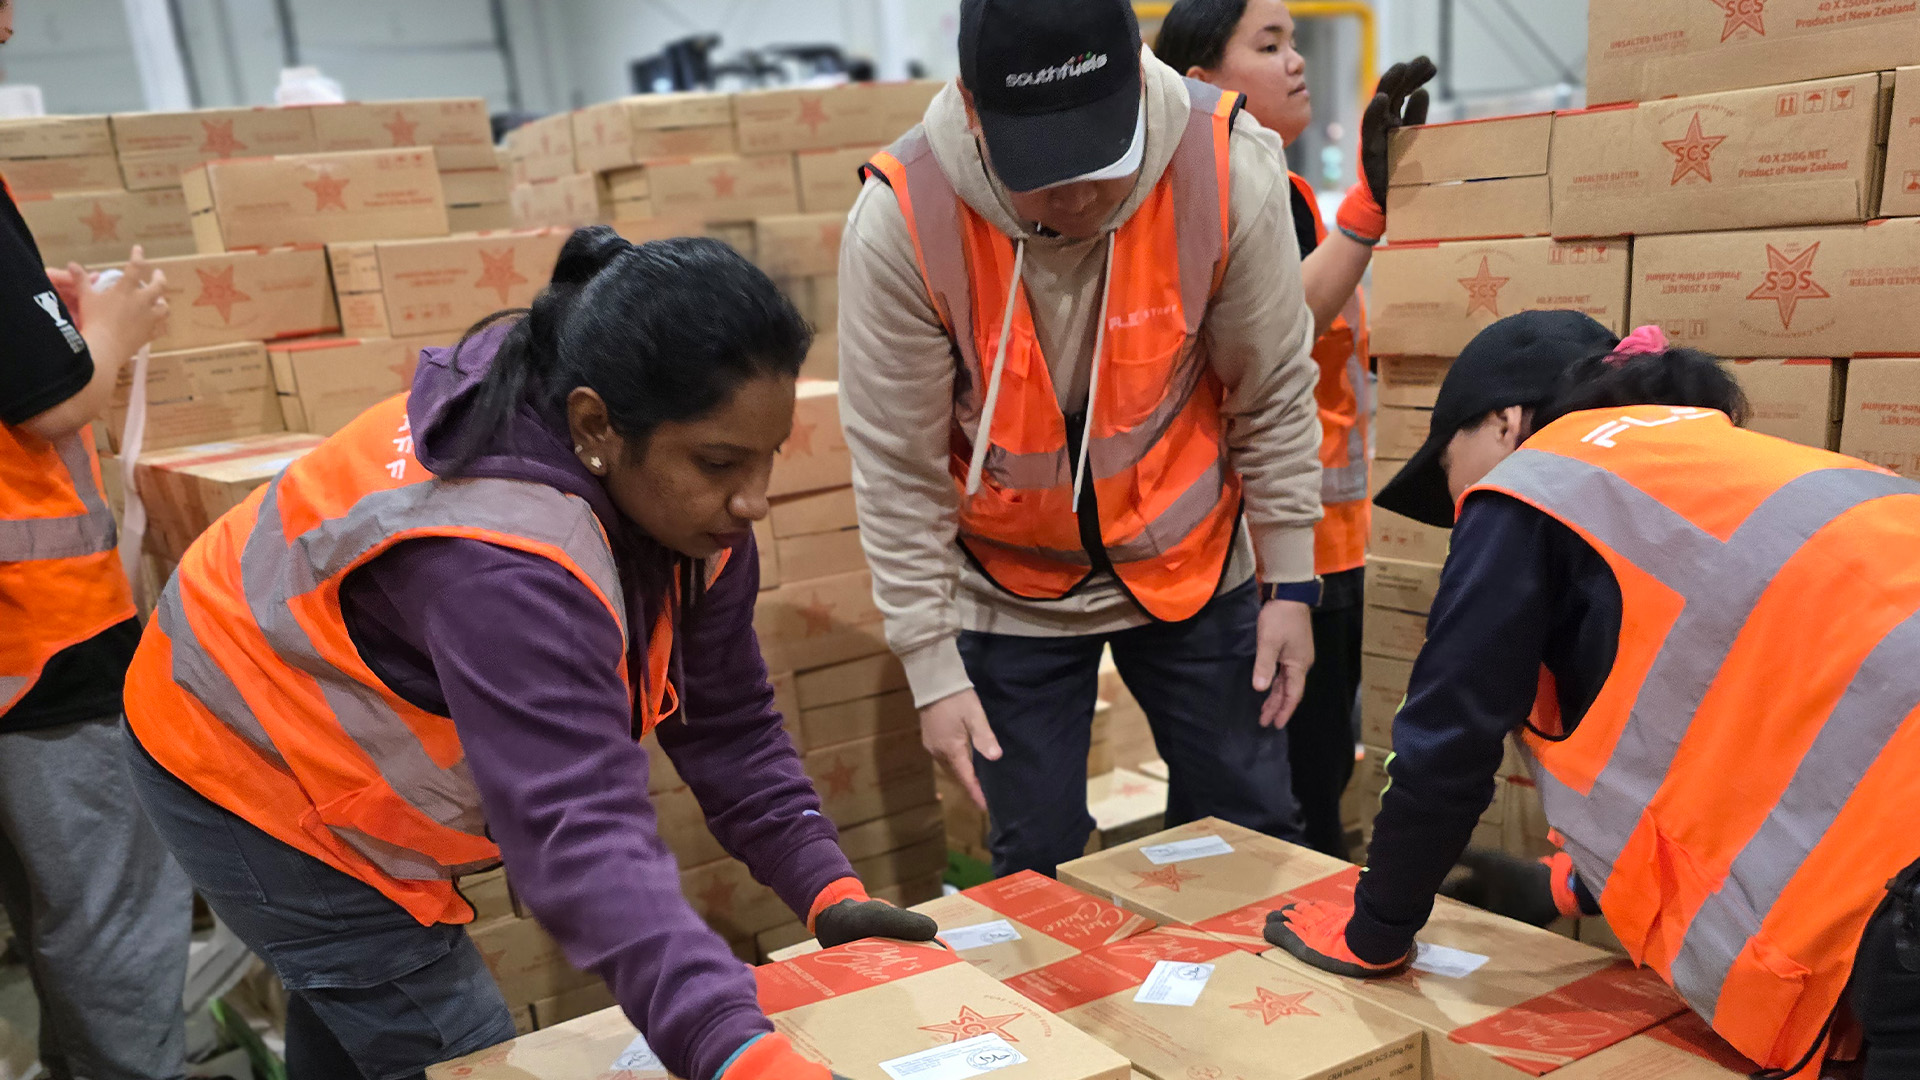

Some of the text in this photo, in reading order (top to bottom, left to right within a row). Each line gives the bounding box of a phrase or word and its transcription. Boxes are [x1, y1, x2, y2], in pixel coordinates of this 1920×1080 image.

[1724, 0, 1764, 18] SCS
[1795, 2, 1917, 29] Product of New Zealand
[1675, 144, 1711, 163] SCS
[1758, 155, 1771, 164] 40
[1807, 149, 1828, 159] NET
[1738, 160, 1848, 178] Product of New Zealand
[1469, 283, 1498, 298] SCS
[1765, 270, 1812, 292] SCS
[844, 941, 923, 971] Chef's
[813, 952, 891, 981] Choice
